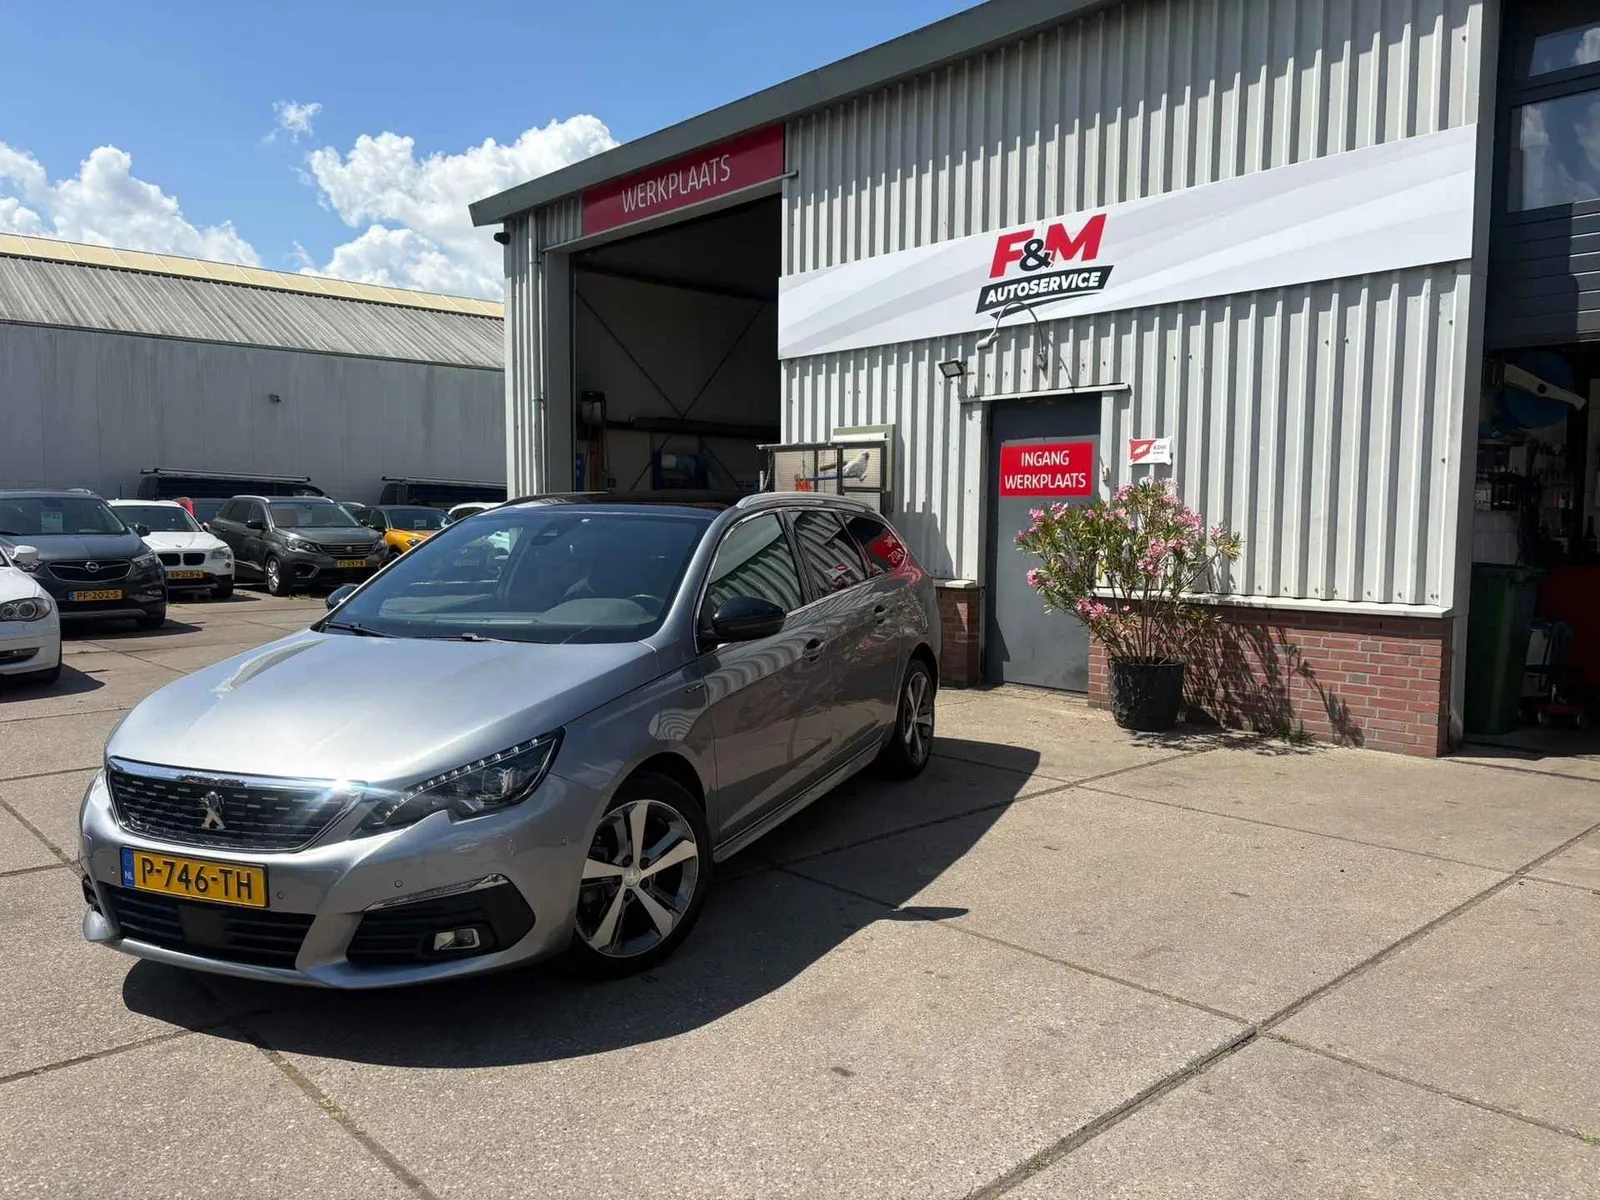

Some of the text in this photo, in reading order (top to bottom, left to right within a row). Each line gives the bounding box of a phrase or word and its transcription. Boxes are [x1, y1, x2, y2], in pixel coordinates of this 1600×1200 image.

[621, 154, 732, 213] WERKPLAATS
[989, 213, 1108, 279] F&M
[985, 271, 1102, 305] AUTOSERVICE
[1021, 450, 1070, 468] INGANG
[1004, 472, 1087, 490] WERKPLAATS
[141, 856, 253, 900] P-746-TH
